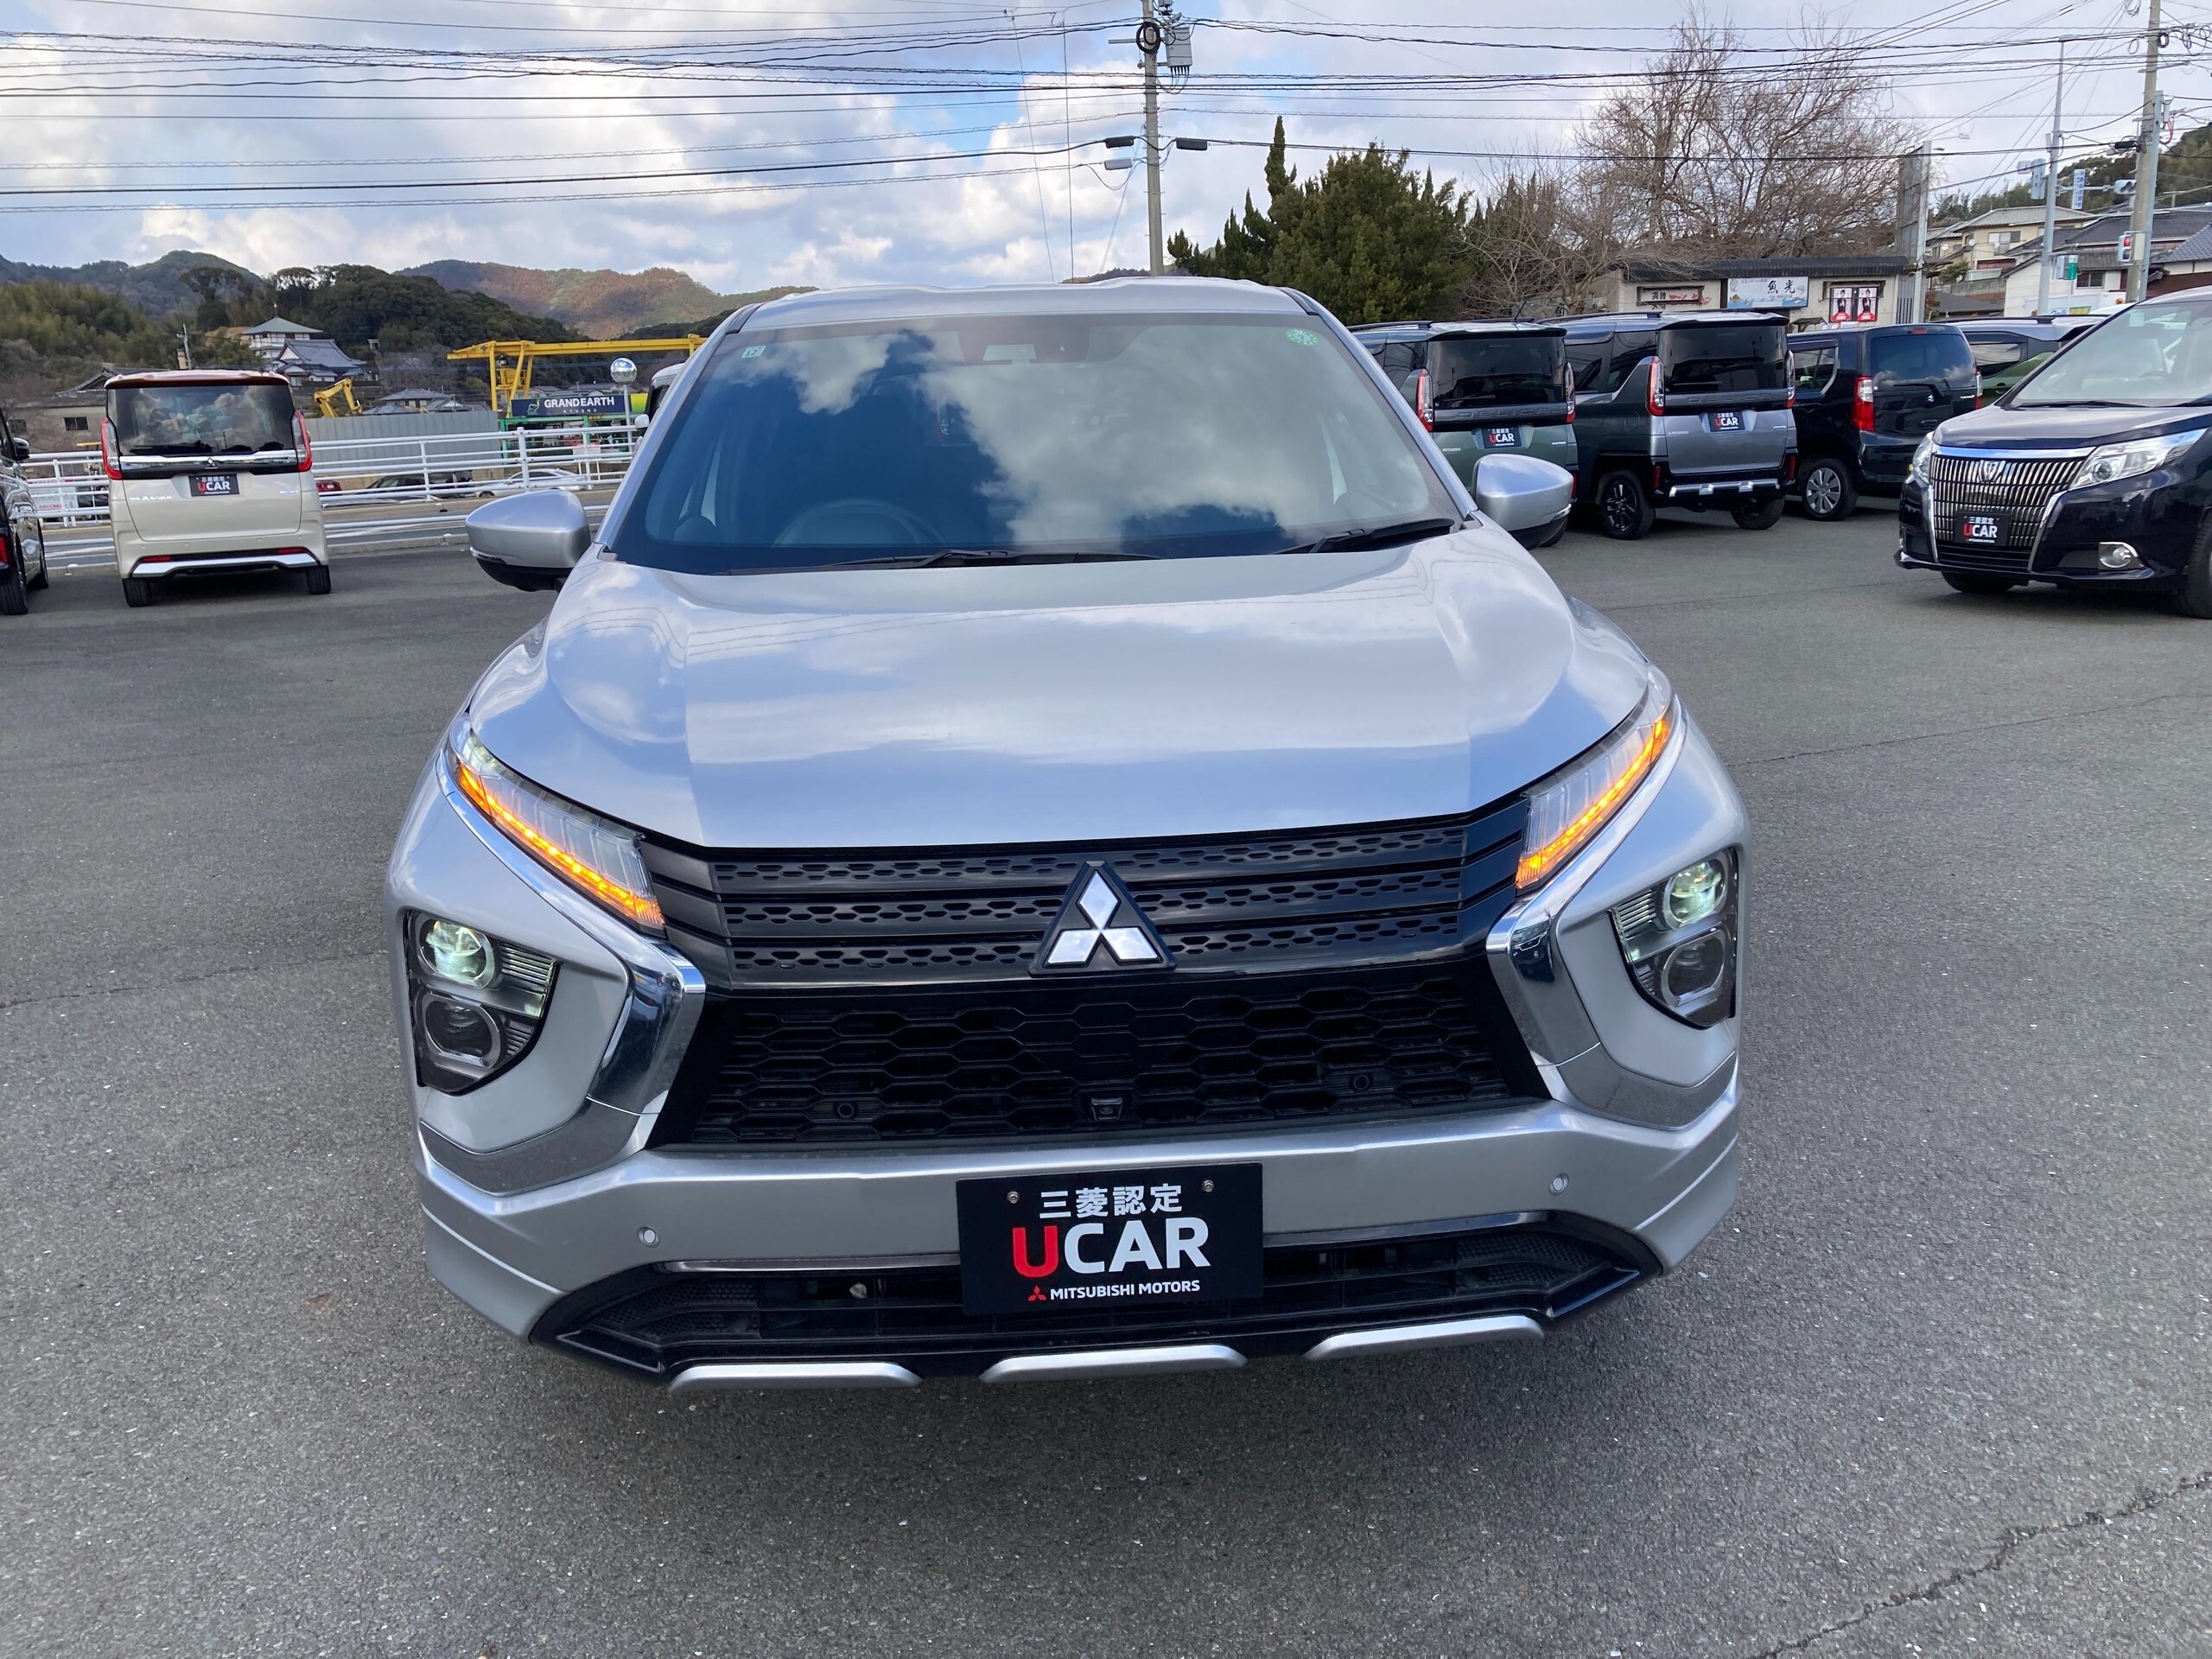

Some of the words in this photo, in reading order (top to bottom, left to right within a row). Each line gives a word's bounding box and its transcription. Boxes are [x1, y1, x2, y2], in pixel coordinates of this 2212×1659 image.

[1767, 279, 1796, 295] 魚光
[544, 397, 614, 408] GRANDEARTH
[1489, 433, 1515, 443] UCAR
[197, 480, 231, 492] UCAR
[1964, 524, 1998, 537] UCAR
[1039, 1183, 1183, 1219] 三菱認定
[1012, 1217, 1211, 1278] UCAR
[1050, 1283, 1135, 1300] MITSUBISHI
[1138, 1279, 1200, 1294] MOTORS
